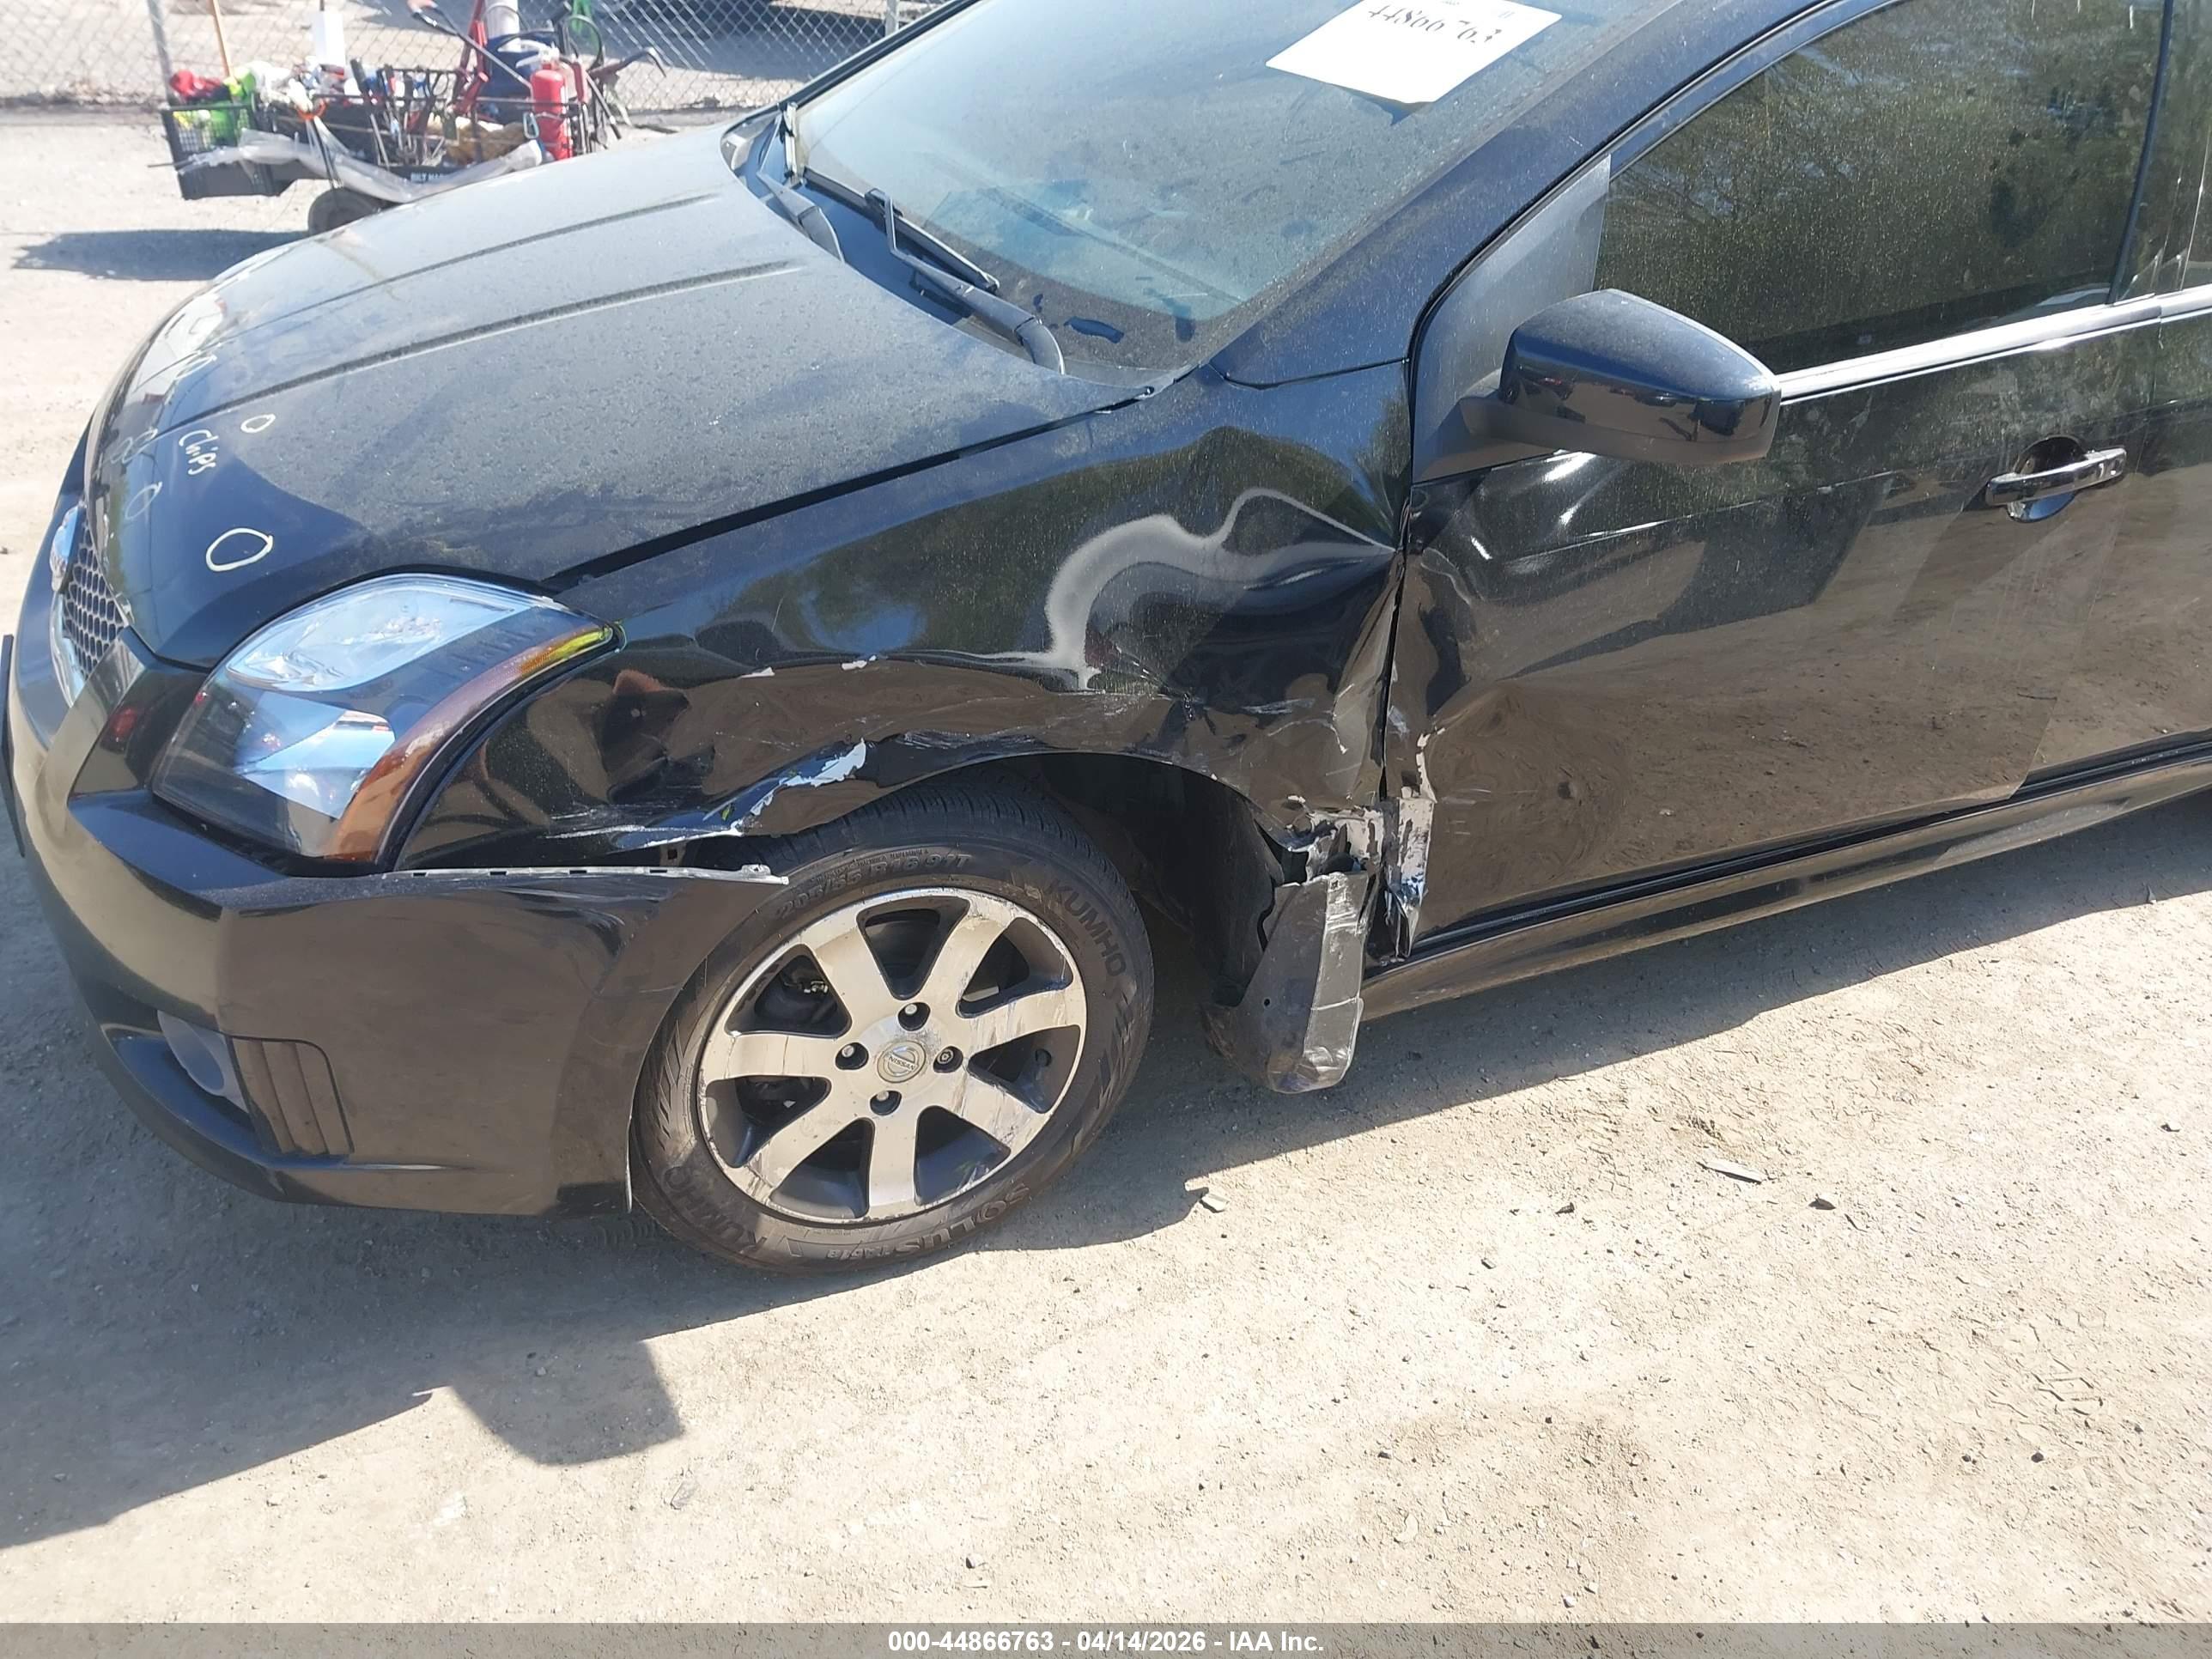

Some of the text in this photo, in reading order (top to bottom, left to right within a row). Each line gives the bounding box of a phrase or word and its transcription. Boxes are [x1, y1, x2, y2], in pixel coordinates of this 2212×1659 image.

[178, 428, 220, 476] Chips
[1044, 878, 1127, 977] KUMHO
[888, 1055, 916, 1071] NISSAN
[662, 1166, 769, 1253] KUMHO
[895, 1182, 1031, 1257] SOLUS
